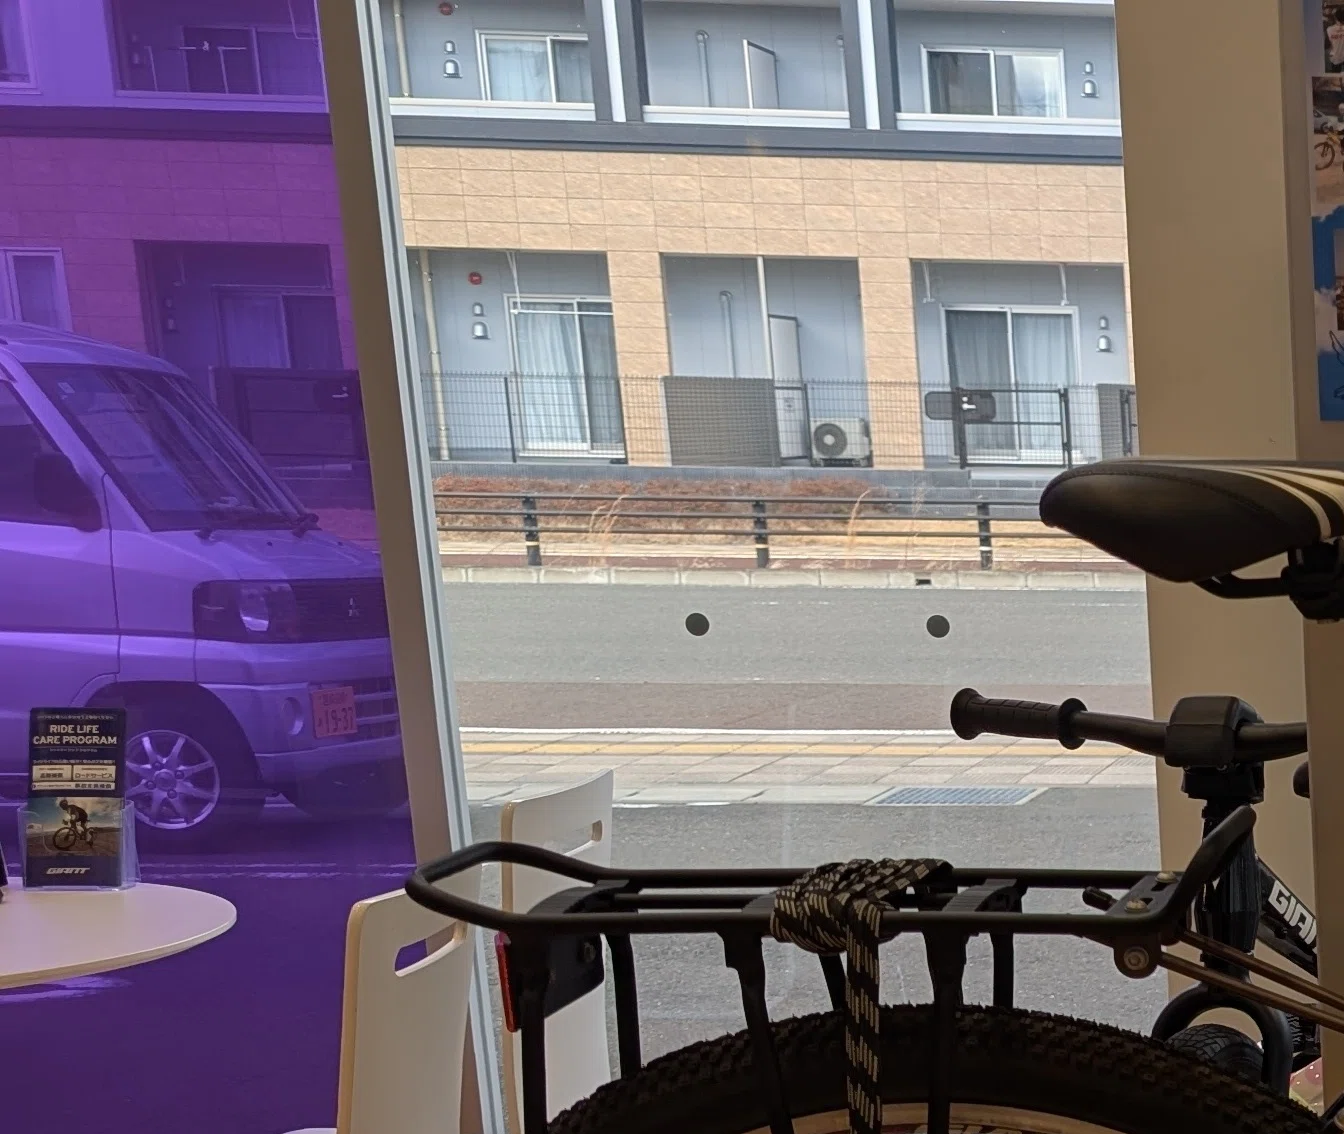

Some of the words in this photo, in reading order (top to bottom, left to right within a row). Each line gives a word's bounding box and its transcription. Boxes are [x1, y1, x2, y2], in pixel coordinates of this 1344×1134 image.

[50, 725, 74, 733] RIDE
[77, 725, 99, 733] LIFE
[33, 736, 60, 744] CARE
[62, 736, 117, 744] PROGRAM
